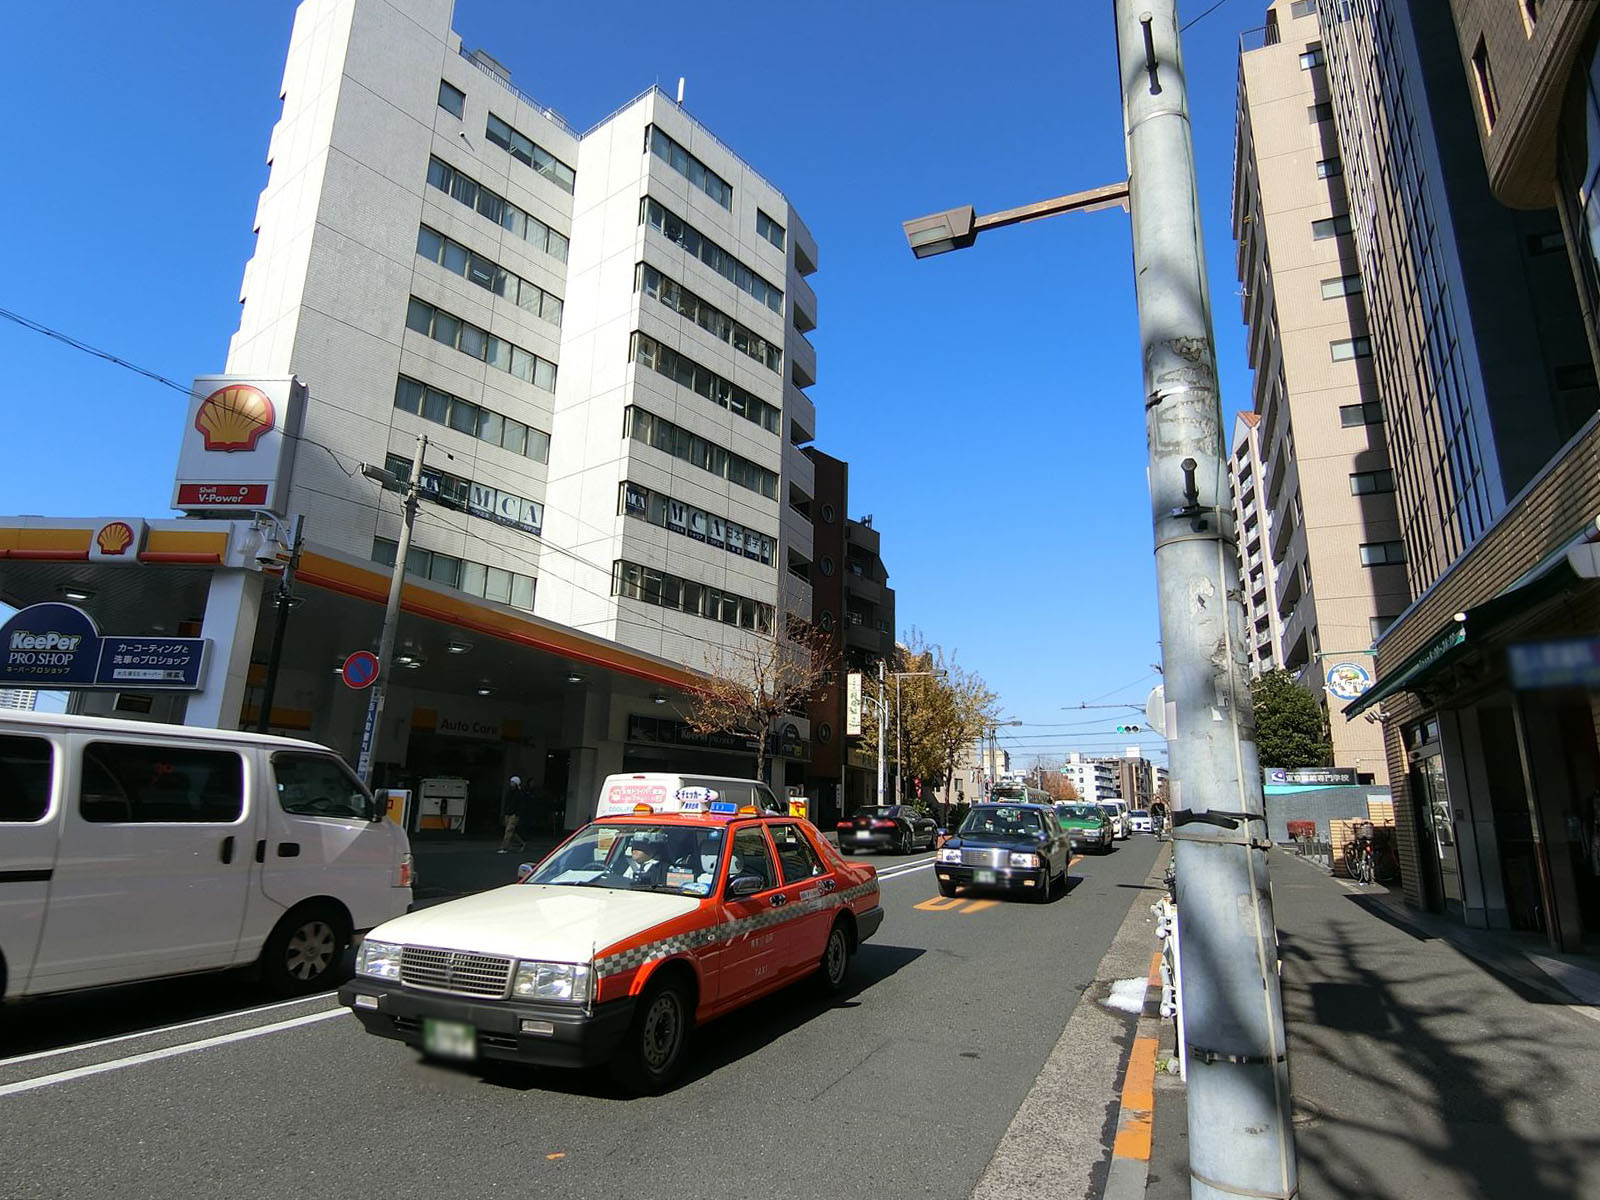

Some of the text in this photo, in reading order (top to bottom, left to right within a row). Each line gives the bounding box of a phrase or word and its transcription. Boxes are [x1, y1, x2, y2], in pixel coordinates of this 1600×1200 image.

[199, 486, 217, 494] Shell
[199, 494, 243, 503] V-Power
[473, 486, 538, 524] MCA
[9, 630, 82, 652] KeePer
[118, 644, 189, 654] カーコーティングと
[8, 652, 74, 666] PRO SHOP
[112, 655, 190, 665] 洗車のプロショップ
[440, 718, 469, 732] Auto
[681, 790, 702, 799] チェッカー
